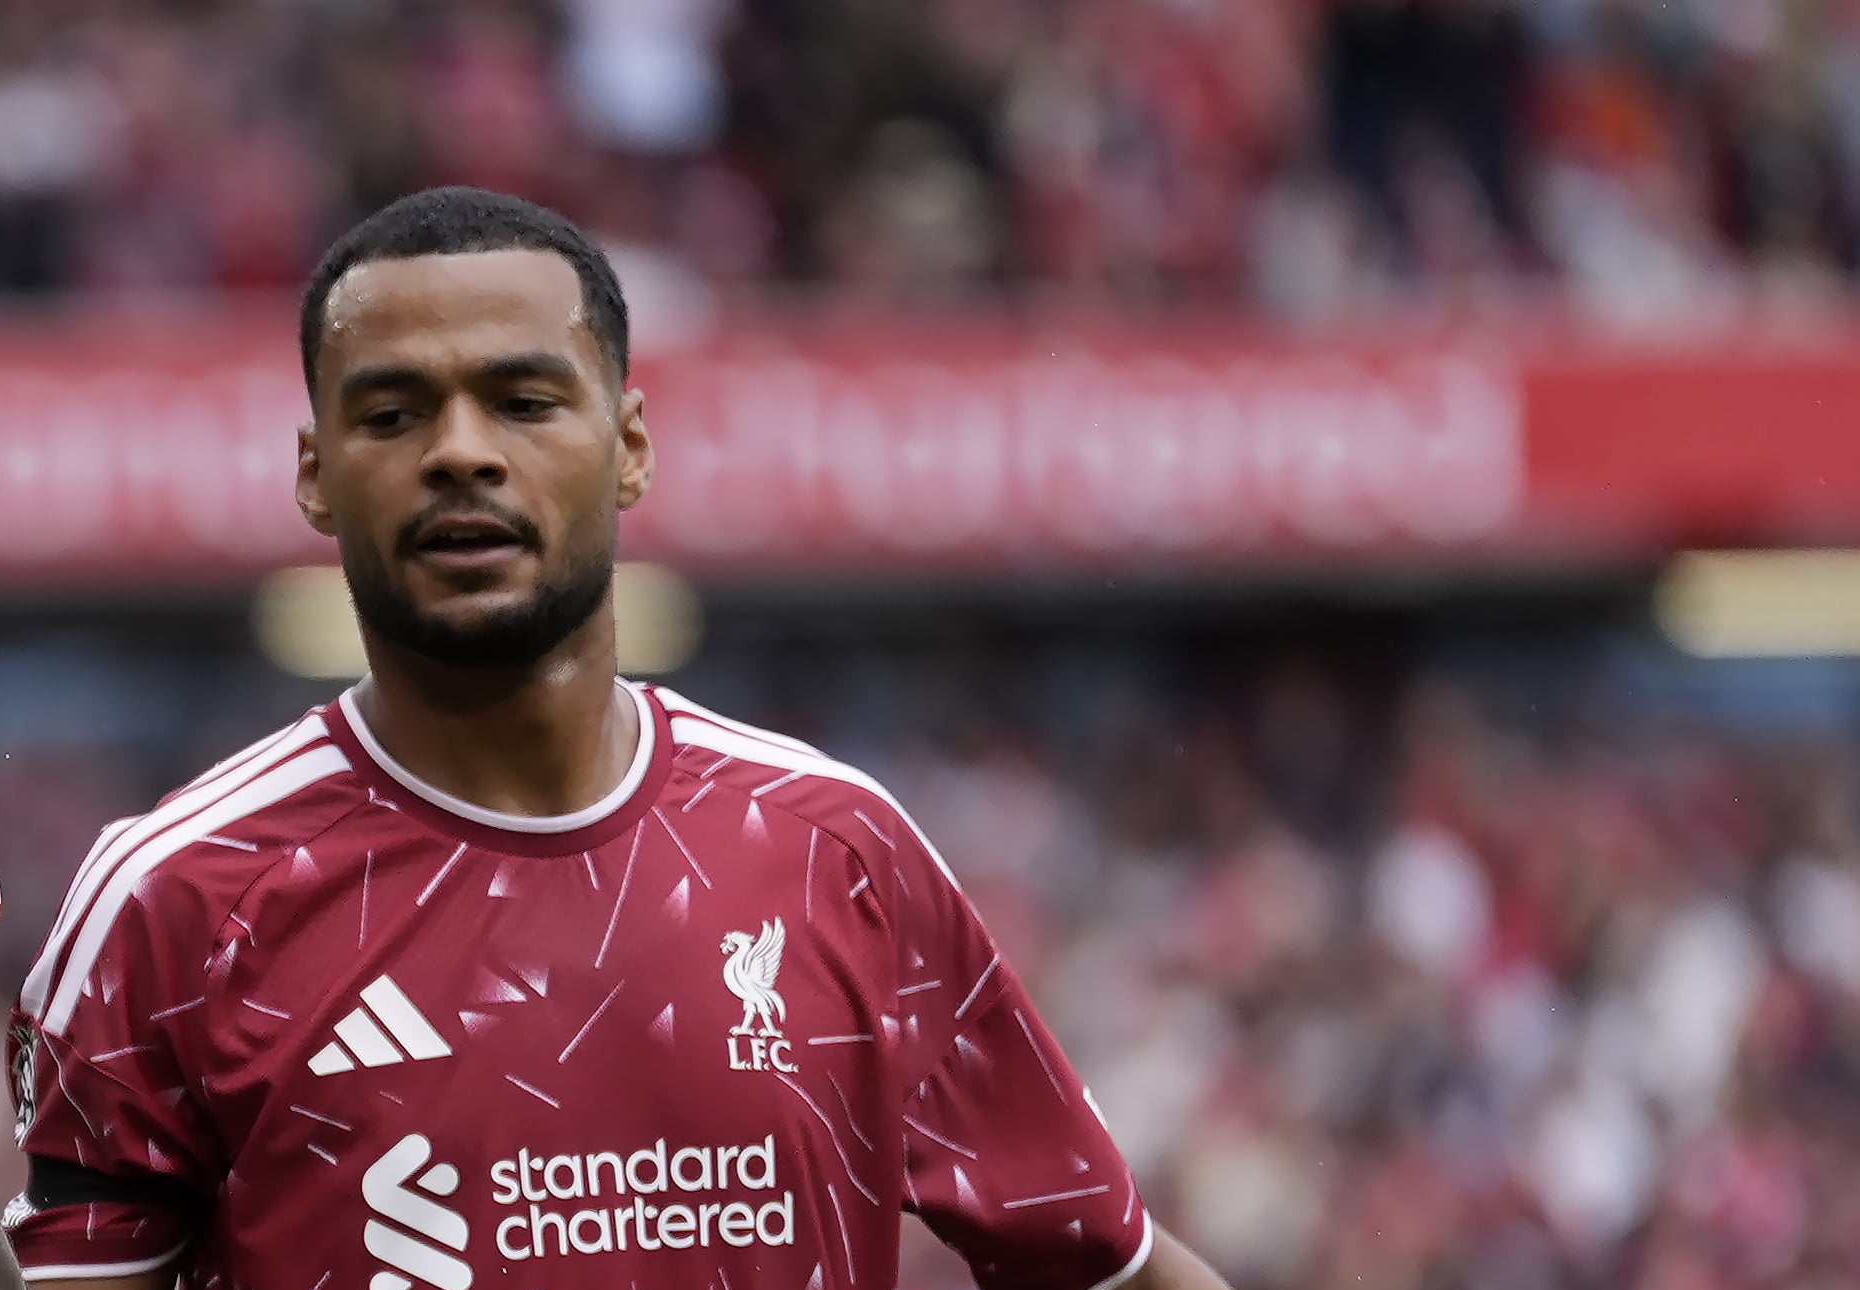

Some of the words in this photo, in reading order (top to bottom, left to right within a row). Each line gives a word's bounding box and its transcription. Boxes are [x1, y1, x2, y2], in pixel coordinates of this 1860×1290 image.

[725, 1036, 800, 1074] L.F.C.
[489, 1133, 777, 1206] standard
[495, 1190, 795, 1261] chartered
